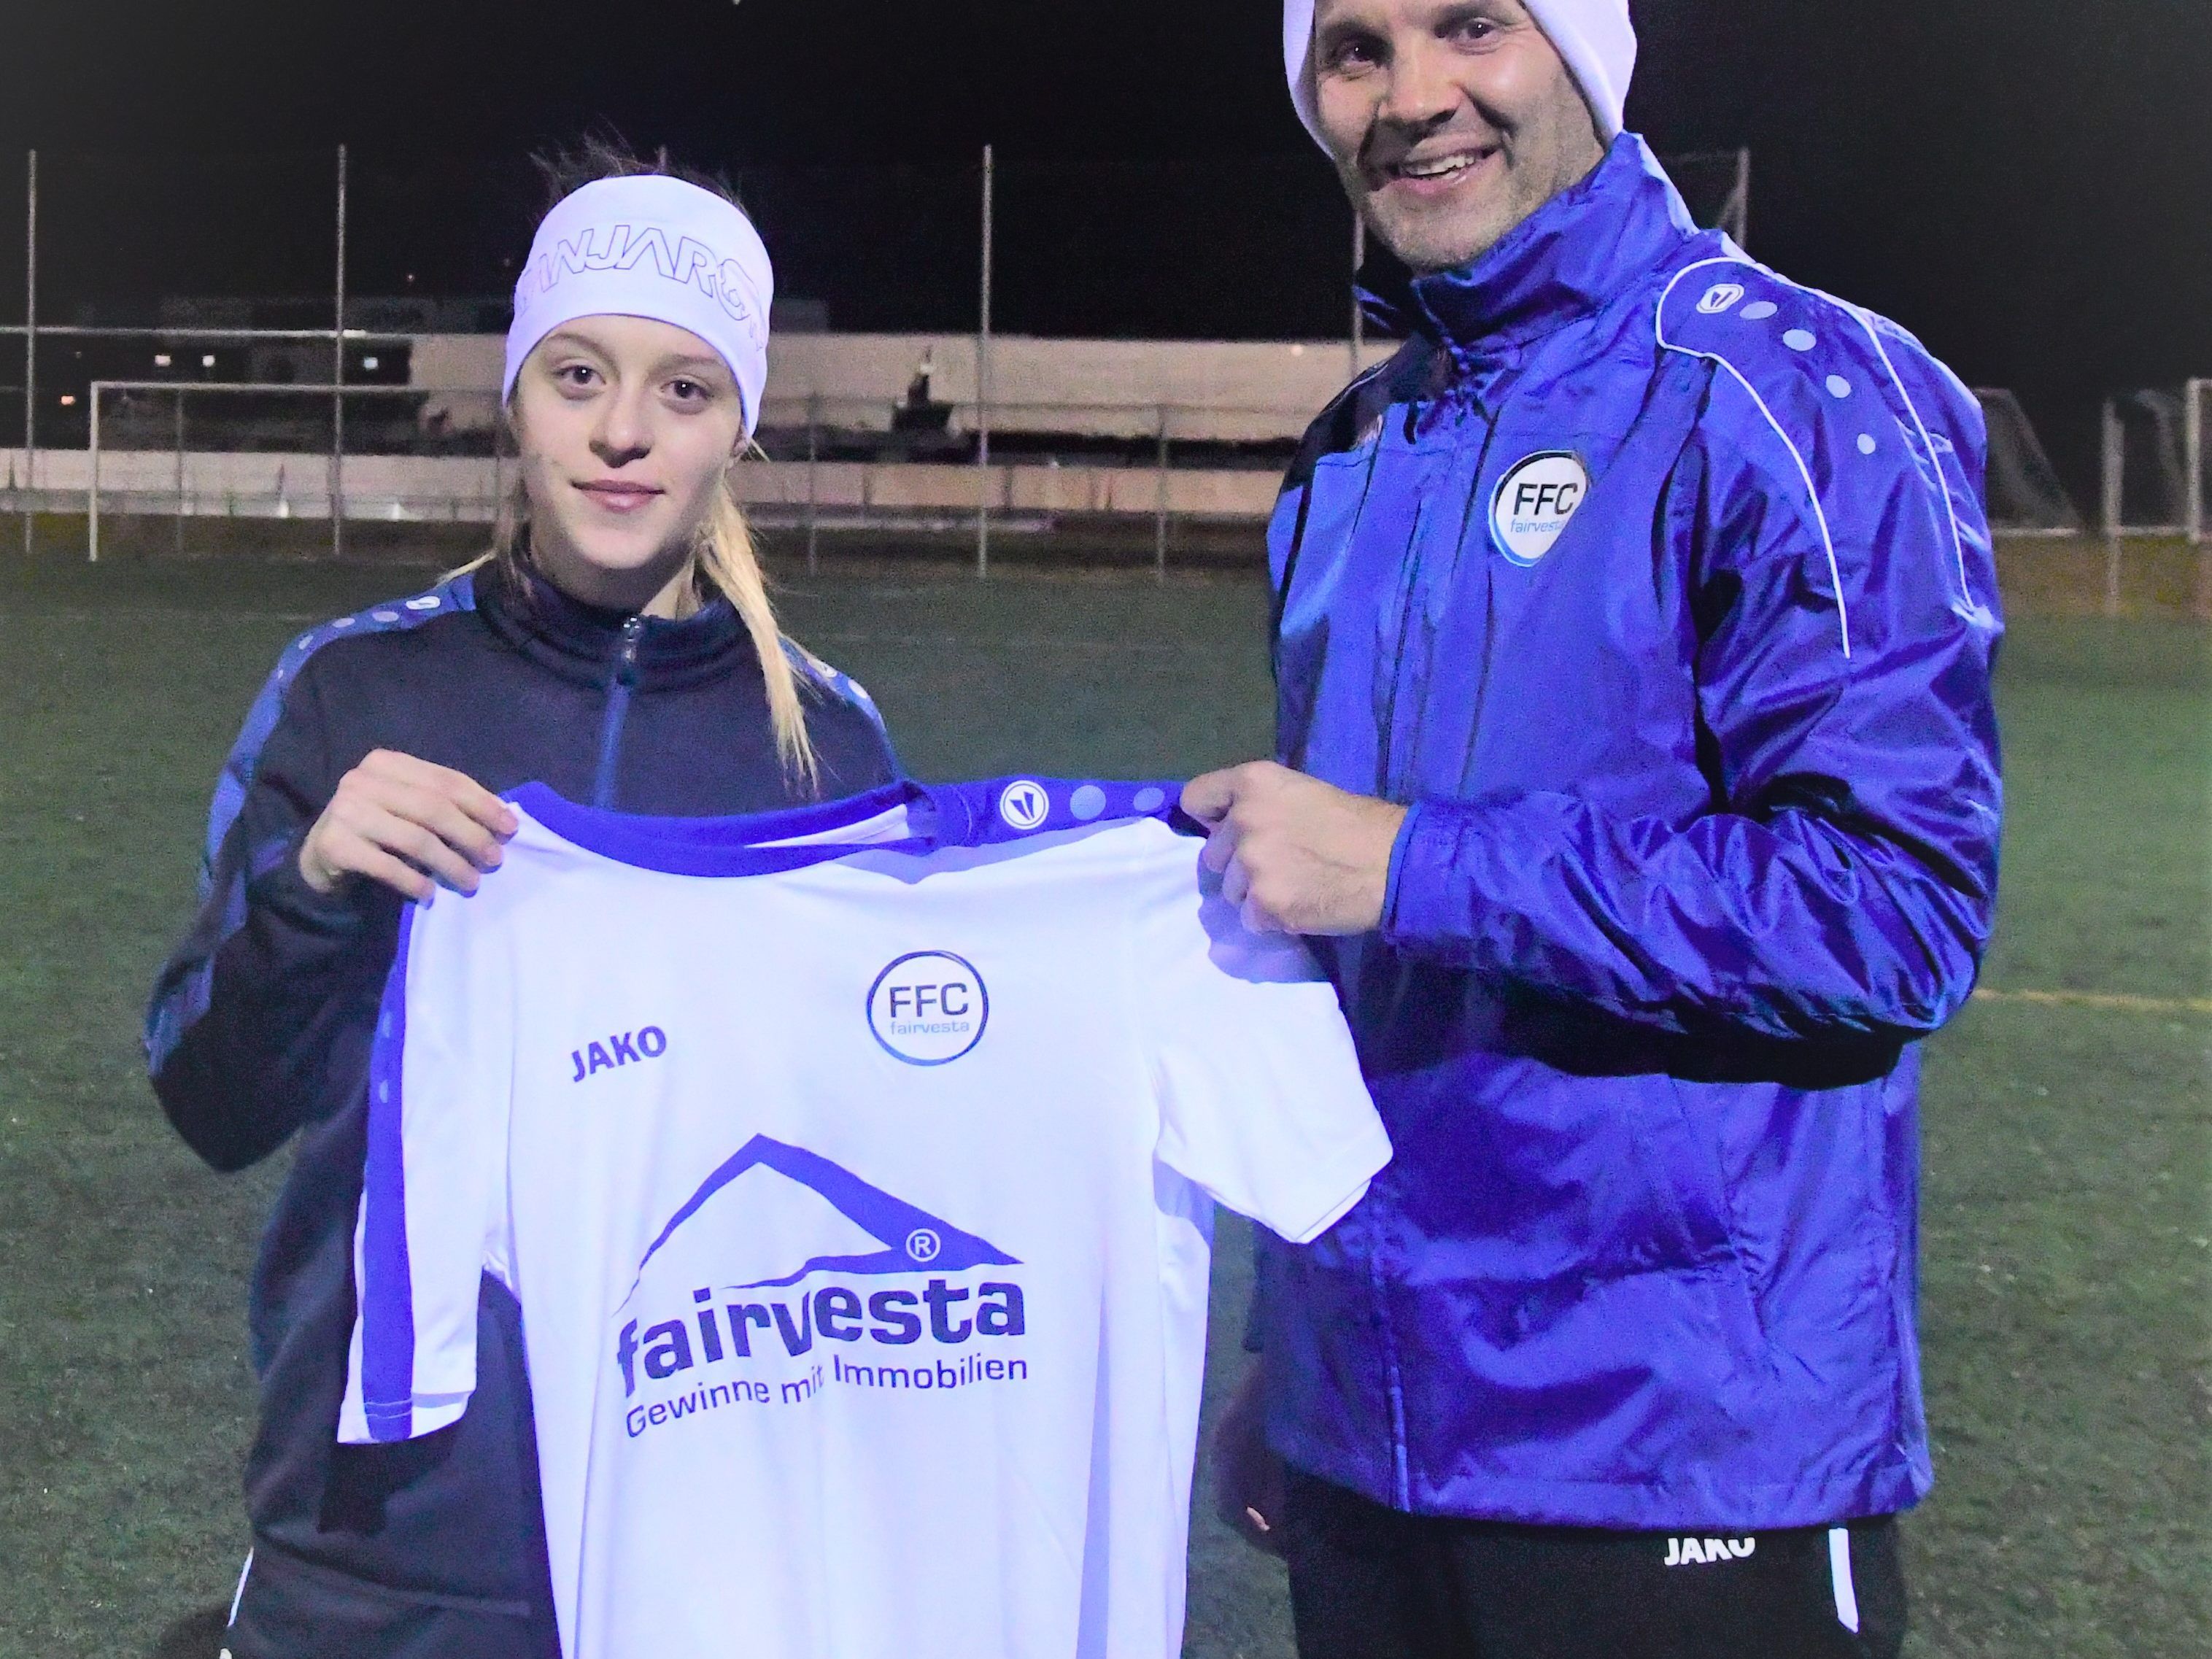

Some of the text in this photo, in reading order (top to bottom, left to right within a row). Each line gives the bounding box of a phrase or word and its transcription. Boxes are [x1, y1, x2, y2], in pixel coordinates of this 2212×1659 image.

[1513, 482, 1578, 515] FFC
[889, 983, 968, 1018] FFC
[889, 1021, 970, 1035] fairvesta
[571, 1026, 667, 1083] JAKO
[616, 1279, 1026, 1398] fairvesta
[626, 1353, 1028, 1438] Gewinne mit Immobilien
